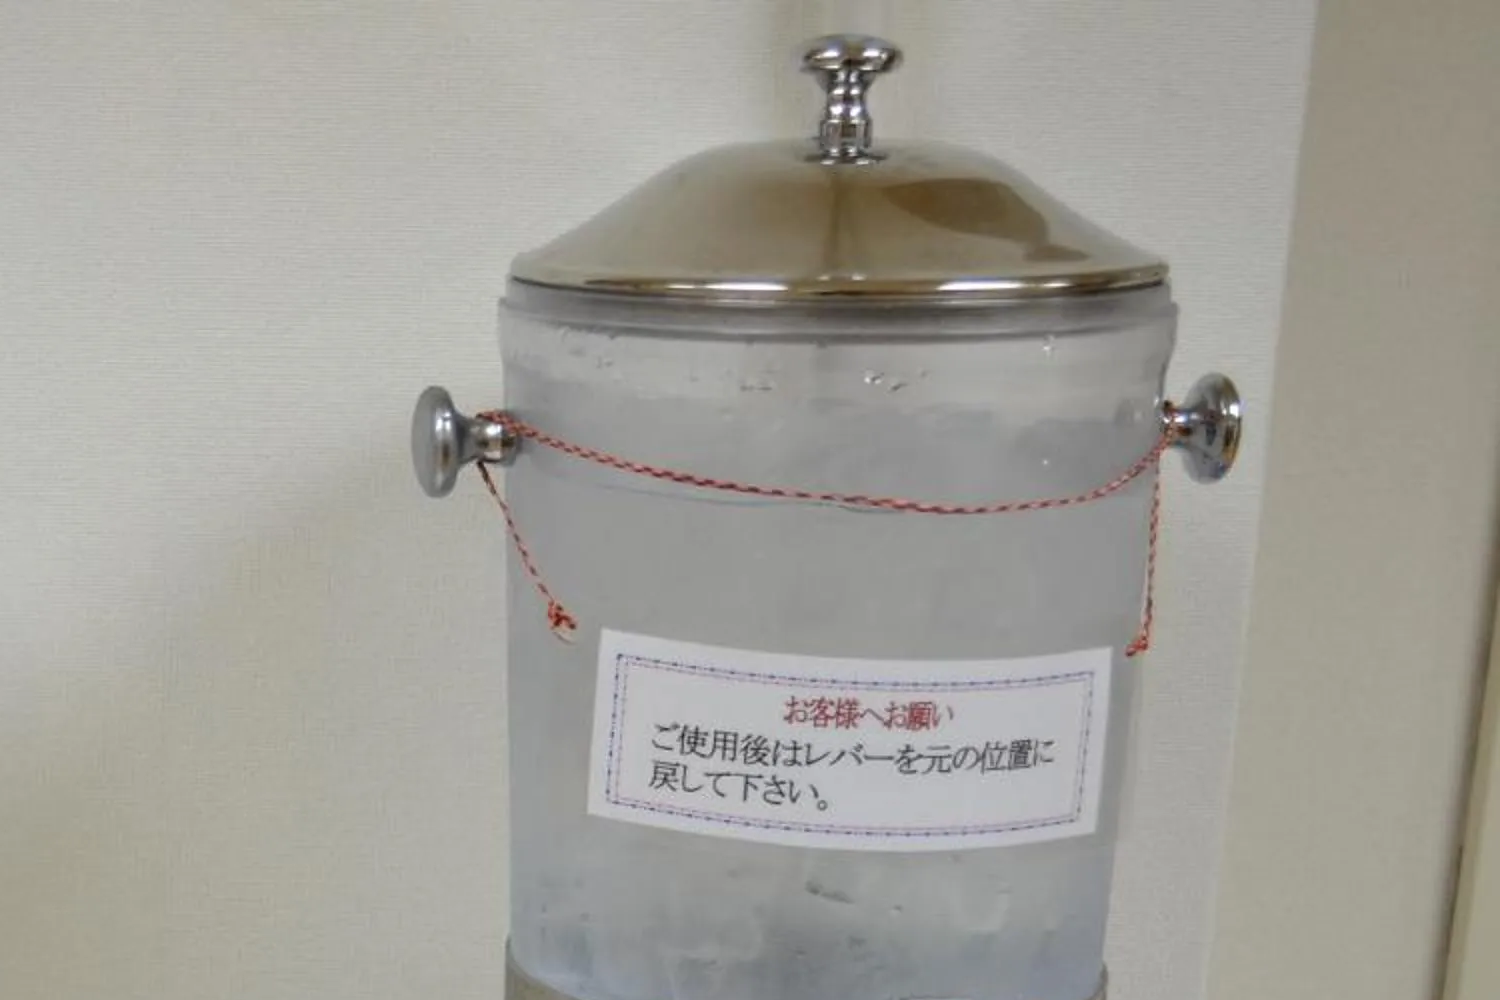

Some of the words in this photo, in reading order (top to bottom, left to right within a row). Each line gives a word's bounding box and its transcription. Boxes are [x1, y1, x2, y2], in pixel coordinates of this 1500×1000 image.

[784, 696, 954, 731] お客様へお願い
[651, 722, 1055, 775] ご使用後はレバーを元の位置に
[649, 760, 828, 811] 戻して下さい。
